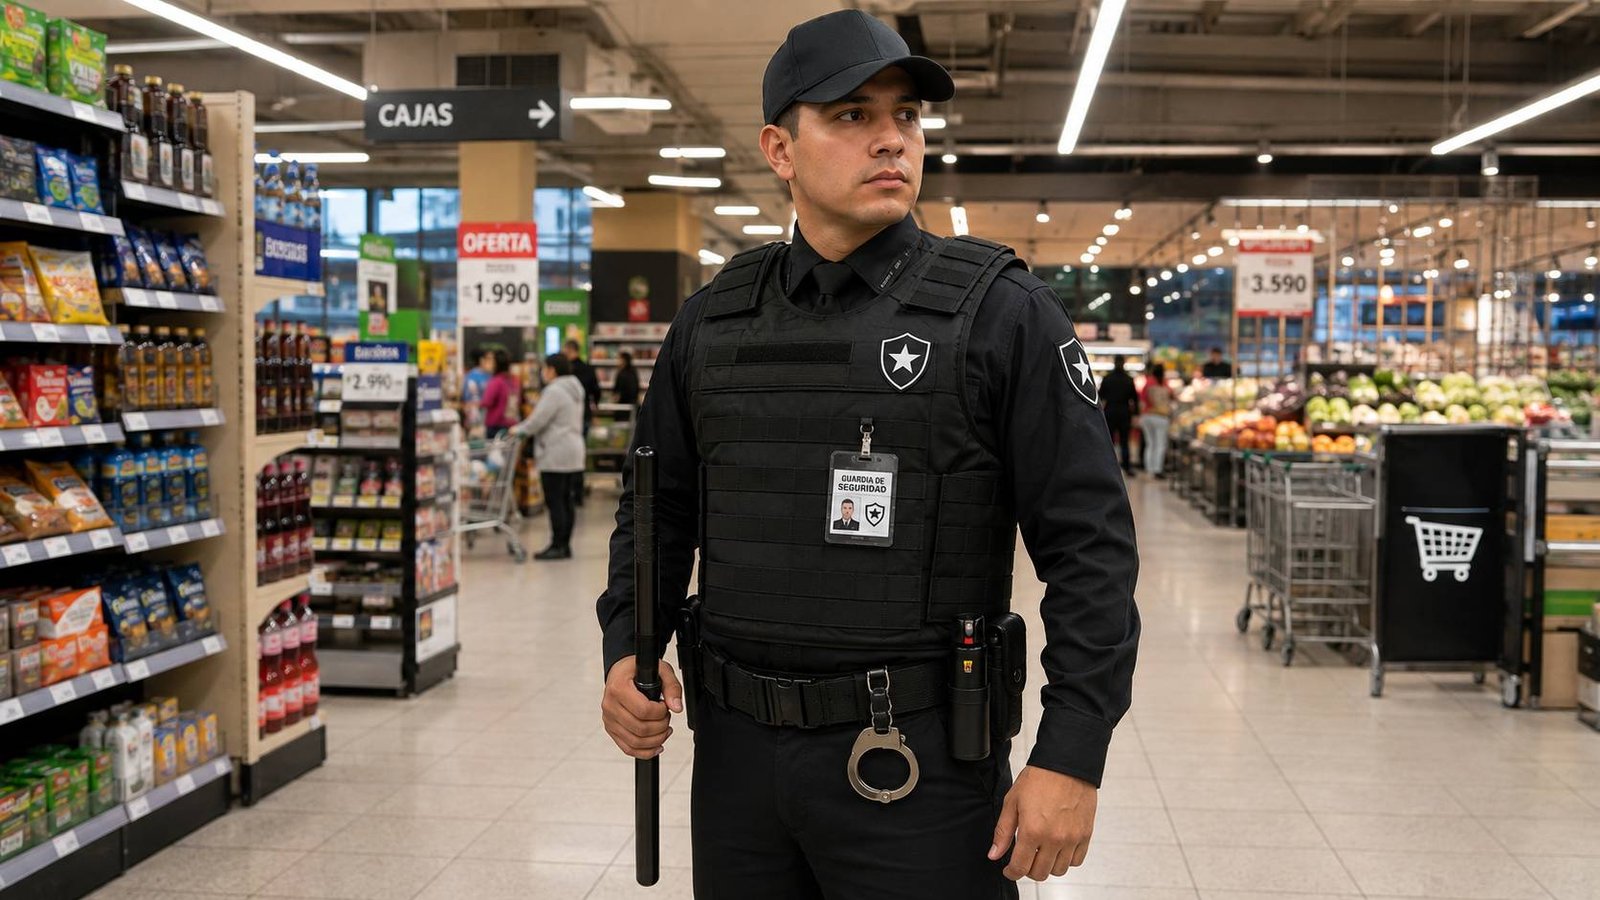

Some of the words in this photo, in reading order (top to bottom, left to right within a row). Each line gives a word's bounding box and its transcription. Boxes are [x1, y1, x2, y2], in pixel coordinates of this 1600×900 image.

[378, 103, 454, 127] CAJAS
[463, 232, 532, 253] OFERTA
[474, 283, 530, 303] 1.990
[1252, 274, 1306, 293] 3.590
[838, 483, 886, 493] SEGURIDAD
[841, 475, 874, 484] GUARDIA
